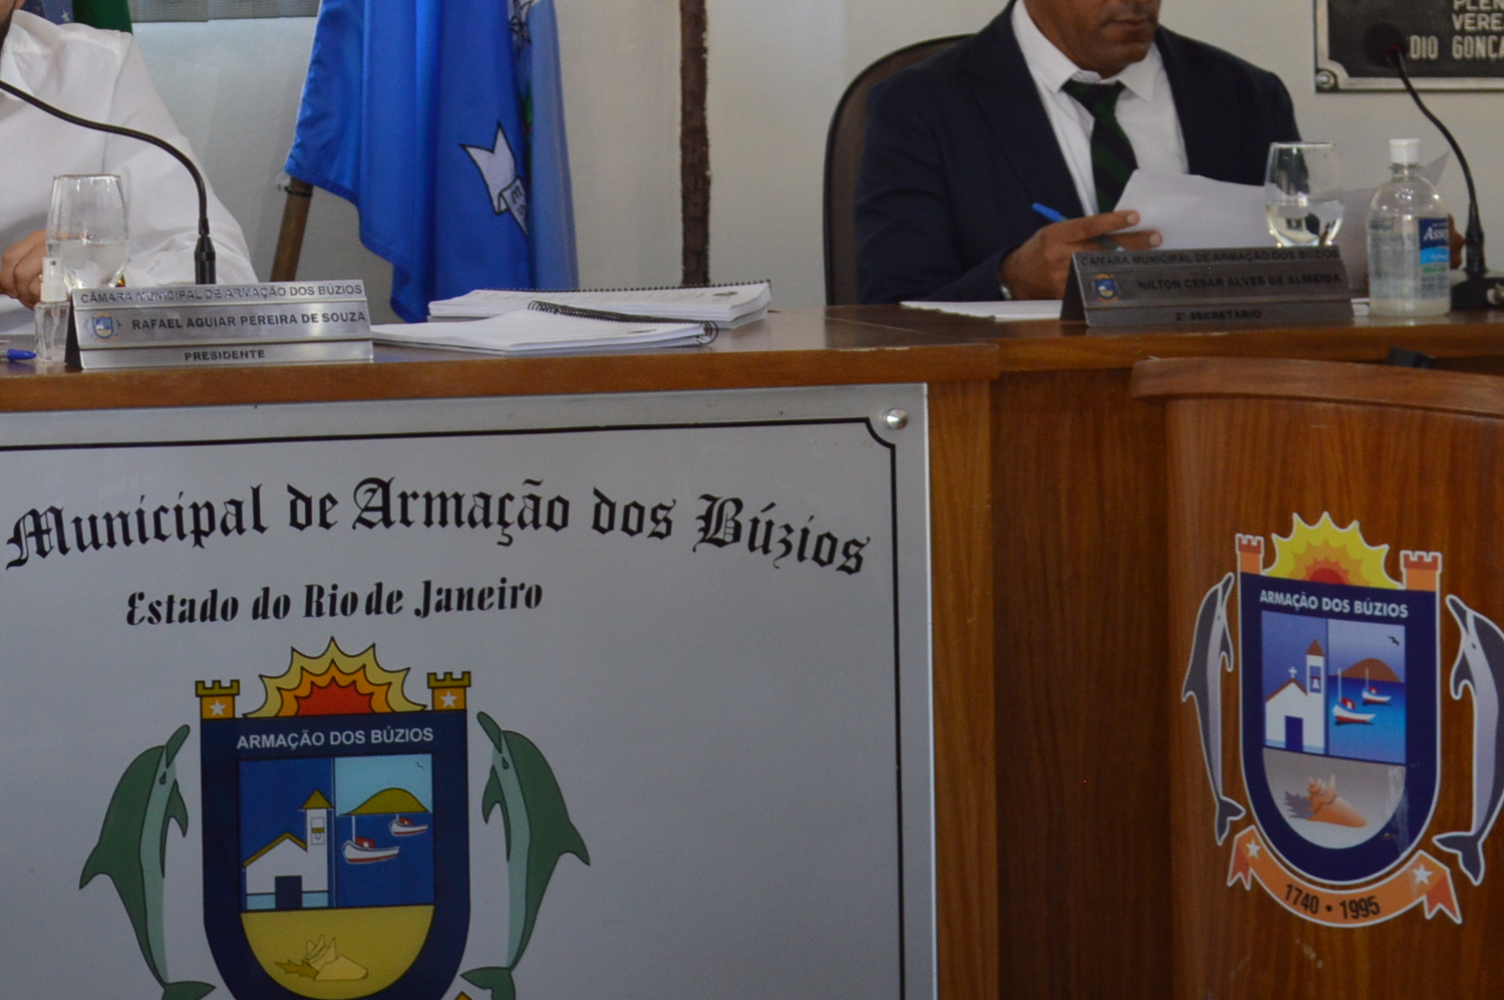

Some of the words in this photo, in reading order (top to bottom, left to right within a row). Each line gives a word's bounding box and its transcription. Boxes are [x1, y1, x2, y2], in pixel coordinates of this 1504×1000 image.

[1132, 253, 1192, 264] MUNICIPAL
[1195, 252, 1210, 263] DE
[1272, 250, 1295, 260] DOS
[1137, 278, 1181, 290] NILTON
[1227, 276, 1265, 287] ALVES
[1268, 275, 1284, 285] DE
[1287, 273, 1341, 284] ALMEIDA
[80, 291, 133, 303] CÂMARA
[136, 289, 202, 301] MUNICIPAL
[206, 289, 221, 299] DE
[225, 286, 286, 298] ARMAÇÃO
[289, 286, 315, 297] DOS
[318, 283, 363, 295] BÚZIOS
[132, 318, 183, 330] RAFAEL
[186, 316, 236, 328] AGUIAR
[240, 314, 298, 326] PEREIRA
[300, 313, 319, 324] DE
[321, 311, 366, 323] SOUZA
[184, 349, 265, 361] PRESIDENTE
[6, 483, 269, 571] Municipal
[286, 483, 340, 531] de
[352, 477, 571, 547] Armação
[591, 487, 677, 541] dos
[692, 493, 872, 576] Búzios
[126, 588, 239, 627] Estado
[251, 586, 291, 621] do
[302, 583, 358, 619] Rio
[364, 580, 404, 616] de
[413, 577, 544, 619] Janeiro
[1259, 589, 1319, 612] ARMAÇÃO
[1321, 596, 1350, 614] DOS
[1353, 597, 1409, 619] BÚZIOS
[236, 728, 325, 750] ARMAÇÃO
[329, 730, 366, 746] DOS
[370, 725, 434, 744] BÚZIOS
[1284, 882, 1320, 915] 1740
[1338, 895, 1381, 920] 1995
